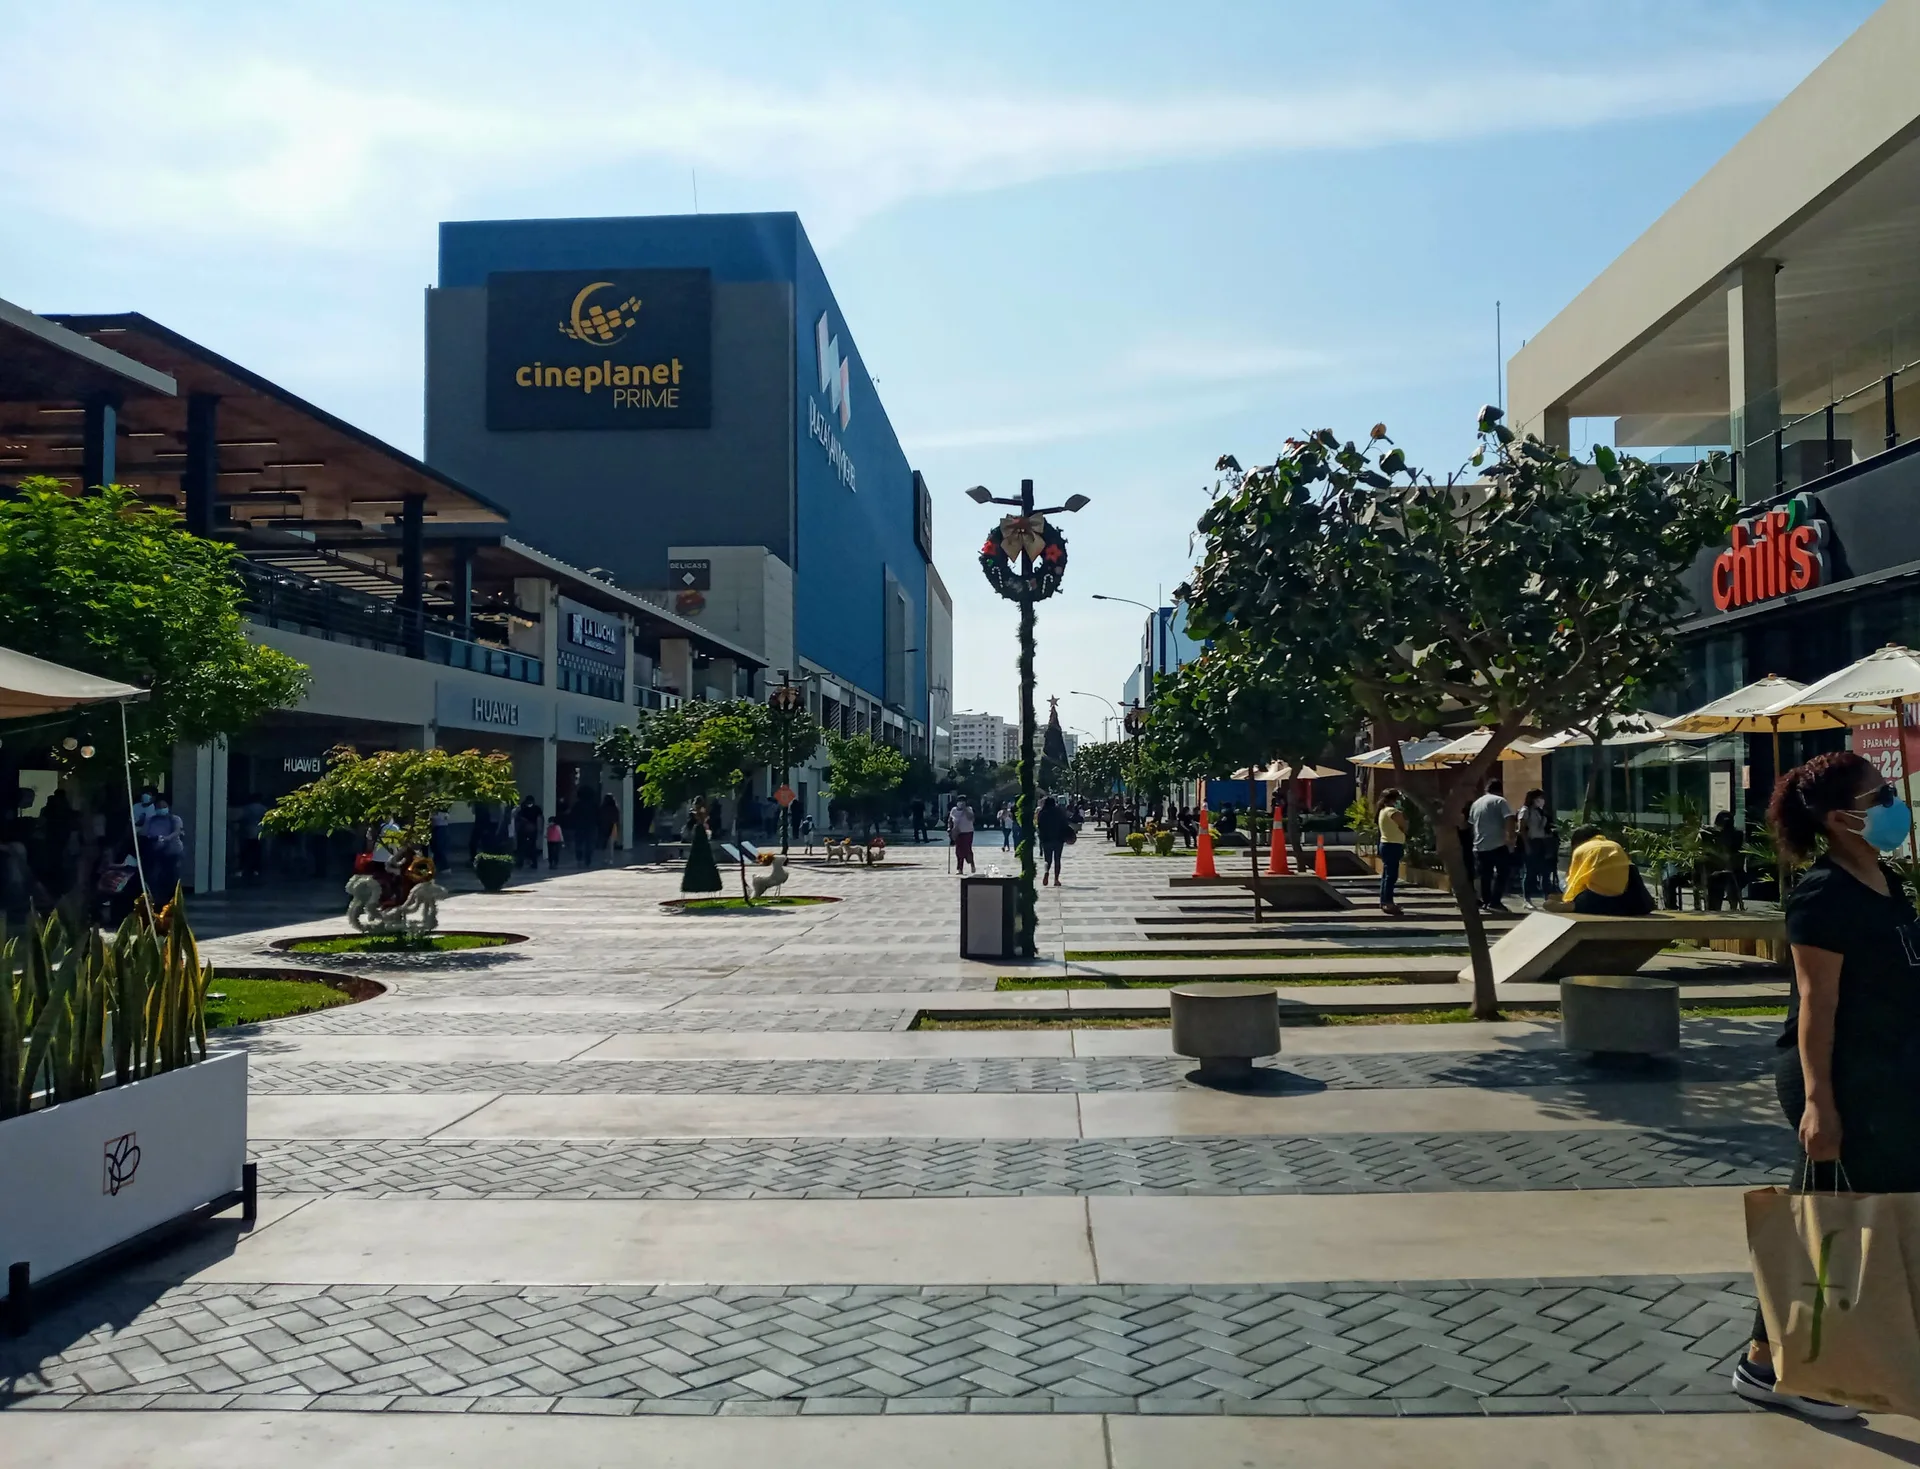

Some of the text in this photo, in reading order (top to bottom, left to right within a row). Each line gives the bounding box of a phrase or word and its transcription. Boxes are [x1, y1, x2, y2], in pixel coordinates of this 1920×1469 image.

[515, 358, 683, 394] cineplanet
[613, 388, 680, 409] PRIME
[1712, 499, 1815, 611] chili's
[584, 617, 616, 643] LA LUCHA
[1843, 688, 1905, 699] Corona
[474, 697, 519, 726] HUAWEI
[1867, 738, 1884, 748] PARA
[283, 758, 321, 773] HUAWEI
